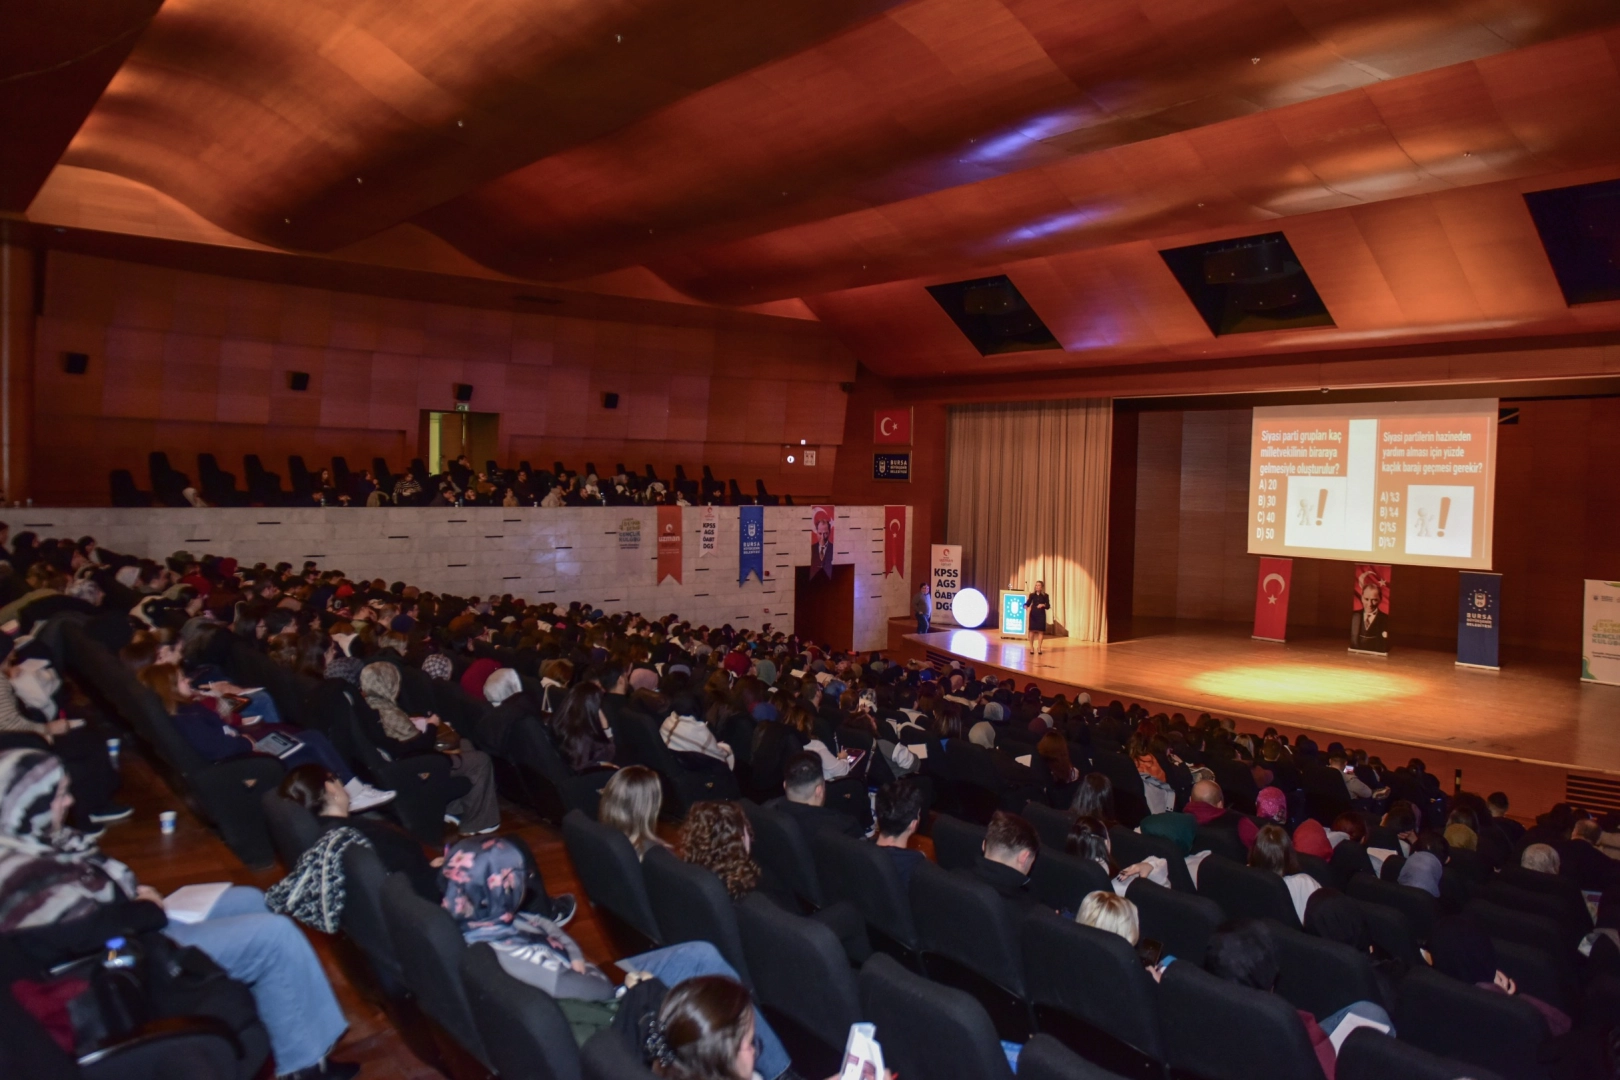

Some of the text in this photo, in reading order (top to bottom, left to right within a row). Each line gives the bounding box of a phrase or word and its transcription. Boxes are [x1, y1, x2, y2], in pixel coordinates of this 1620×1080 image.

[1262, 429, 1342, 444] Siyasi parti grupları kaç
[1383, 430, 1471, 444] Siyasi partilerin hazineden
[1260, 446, 1337, 460] milletvekilinin biraraya
[1382, 446, 1464, 459] yardım alması için yüzde
[1260, 463, 1340, 476] gelmesiyle oluşturulur?
[1382, 461, 1482, 475] kaçlık barajı geçmesi gerekir?
[1259, 480, 1277, 492] A) 20
[1258, 496, 1276, 508] B) 30
[1380, 492, 1400, 504] A) %3
[1257, 512, 1275, 524] C) 40
[1380, 506, 1399, 519] B) %4
[1256, 528, 1274, 541] D) 50
[934, 568, 958, 578] KPSS
[936, 579, 956, 588] AGS
